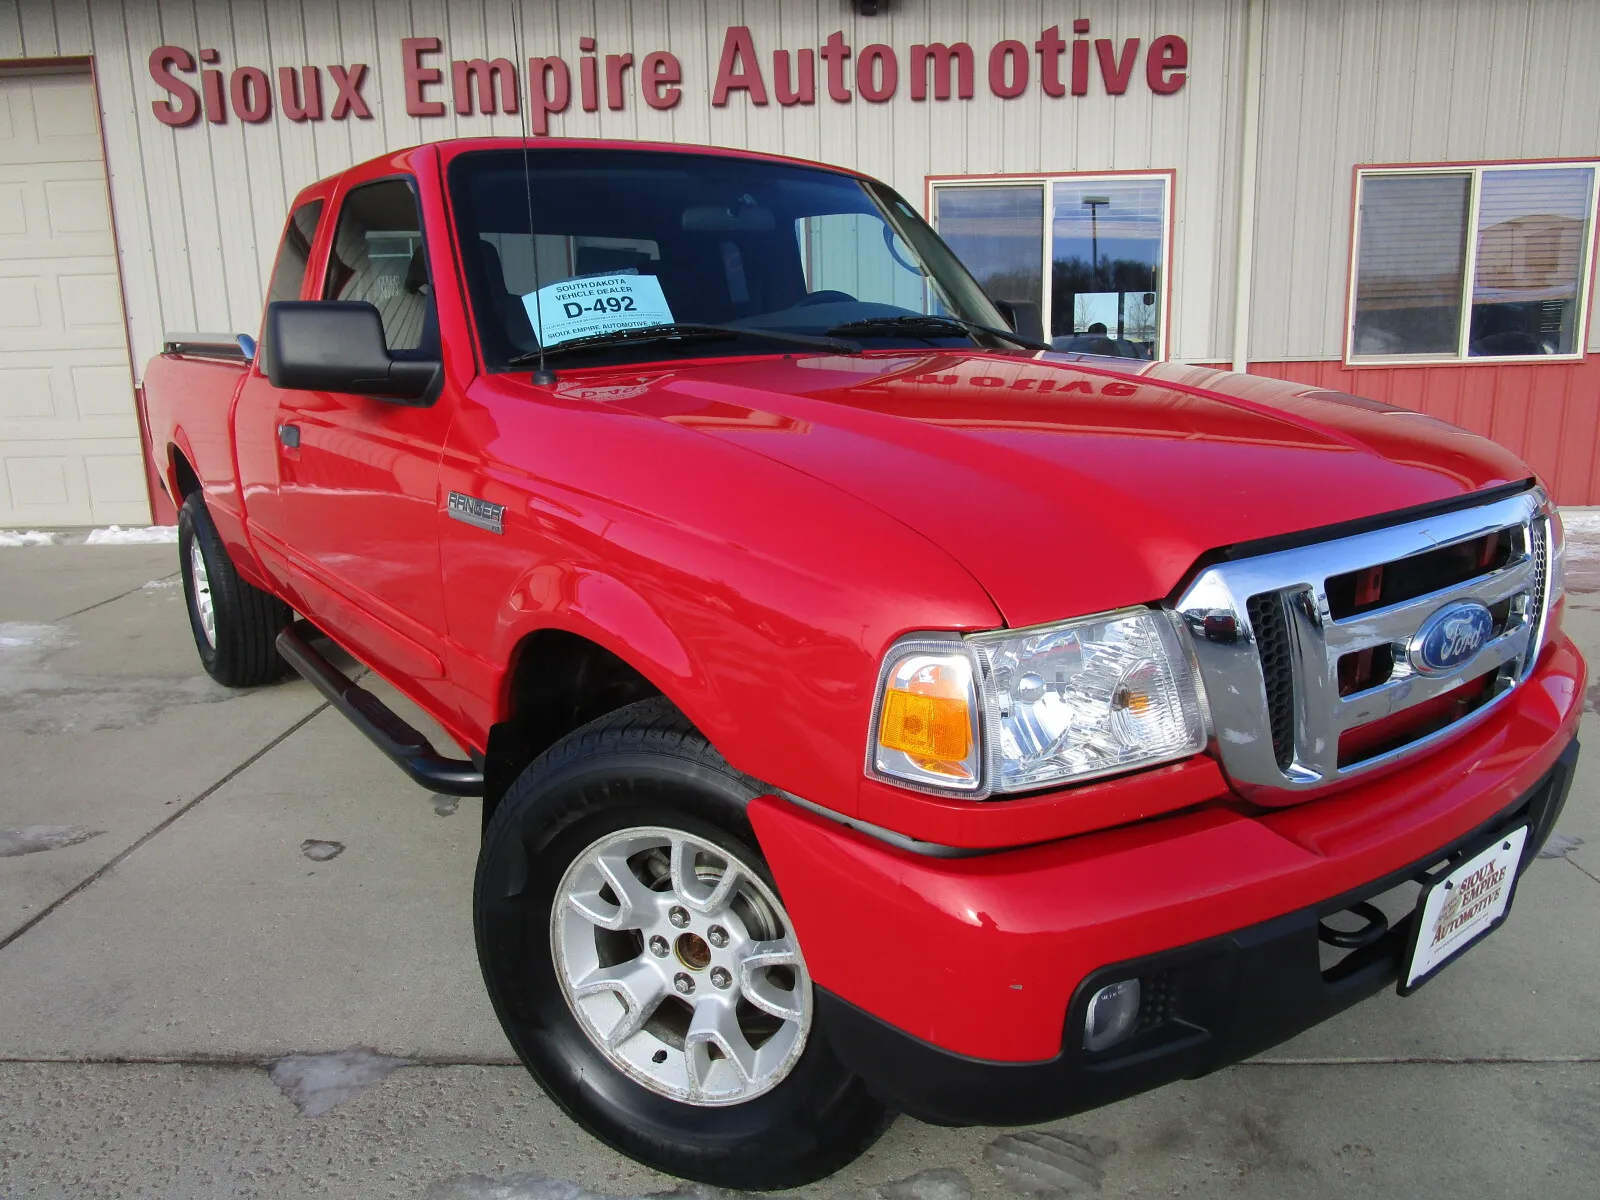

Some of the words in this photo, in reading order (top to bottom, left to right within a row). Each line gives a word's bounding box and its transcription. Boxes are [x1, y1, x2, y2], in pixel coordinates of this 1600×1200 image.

[149, 45, 372, 128] Sioux
[401, 36, 682, 136] Empire
[712, 18, 1188, 107] Automotive
[555, 289, 596, 301] VEHICLE
[597, 286, 633, 295] DEALER
[556, 281, 588, 293] SOUTH
[589, 278, 627, 288] DAKOTA
[563, 295, 637, 319] D-492
[547, 329, 571, 340] SIOUX
[572, 324, 600, 335] EMPIRE
[448, 492, 502, 522] RANGER
[1440, 615, 1484, 660] Ford
[1458, 858, 1497, 895] SIOUX
[1461, 864, 1507, 907] EMPIRE
